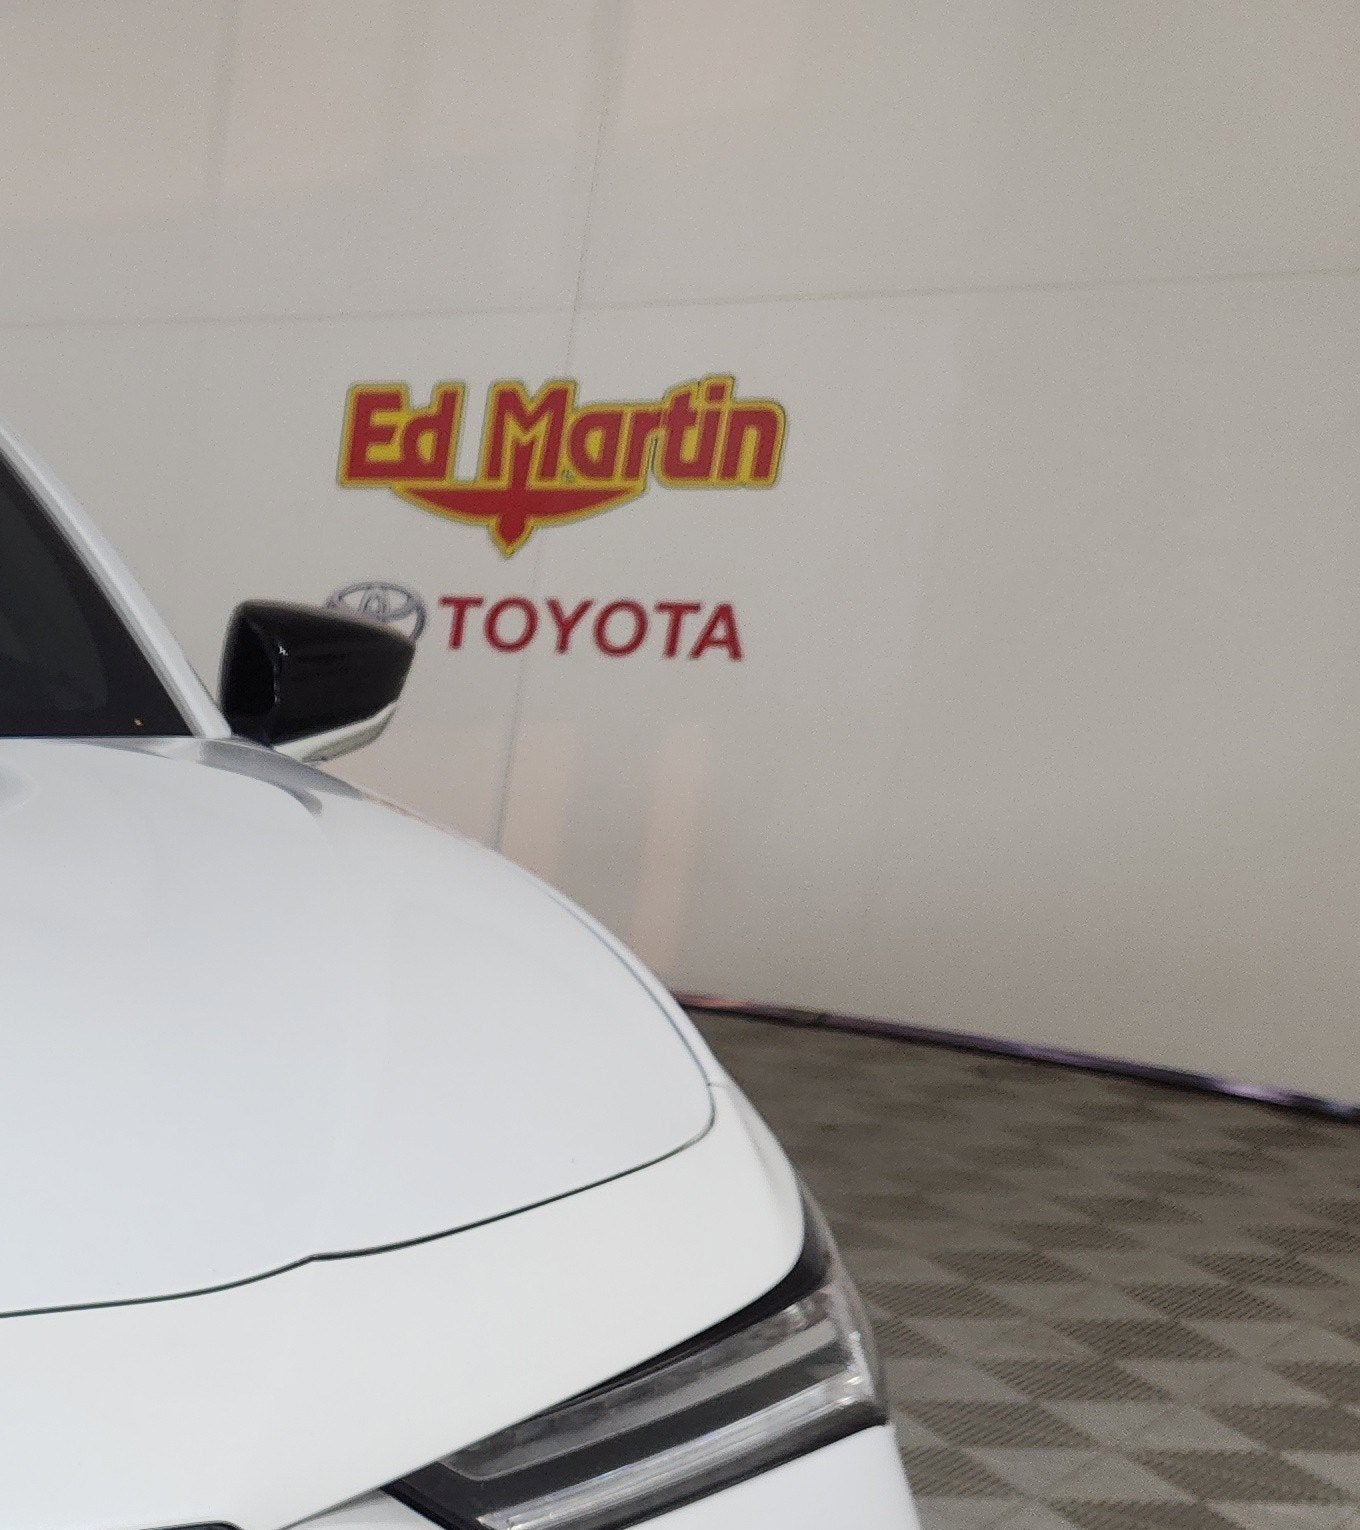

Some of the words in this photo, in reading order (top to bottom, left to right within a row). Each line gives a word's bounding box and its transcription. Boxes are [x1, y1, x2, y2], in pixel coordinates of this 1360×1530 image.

[340, 380, 467, 487] Ed
[483, 376, 785, 487] Martin
[439, 596, 743, 661] TOYOTA
